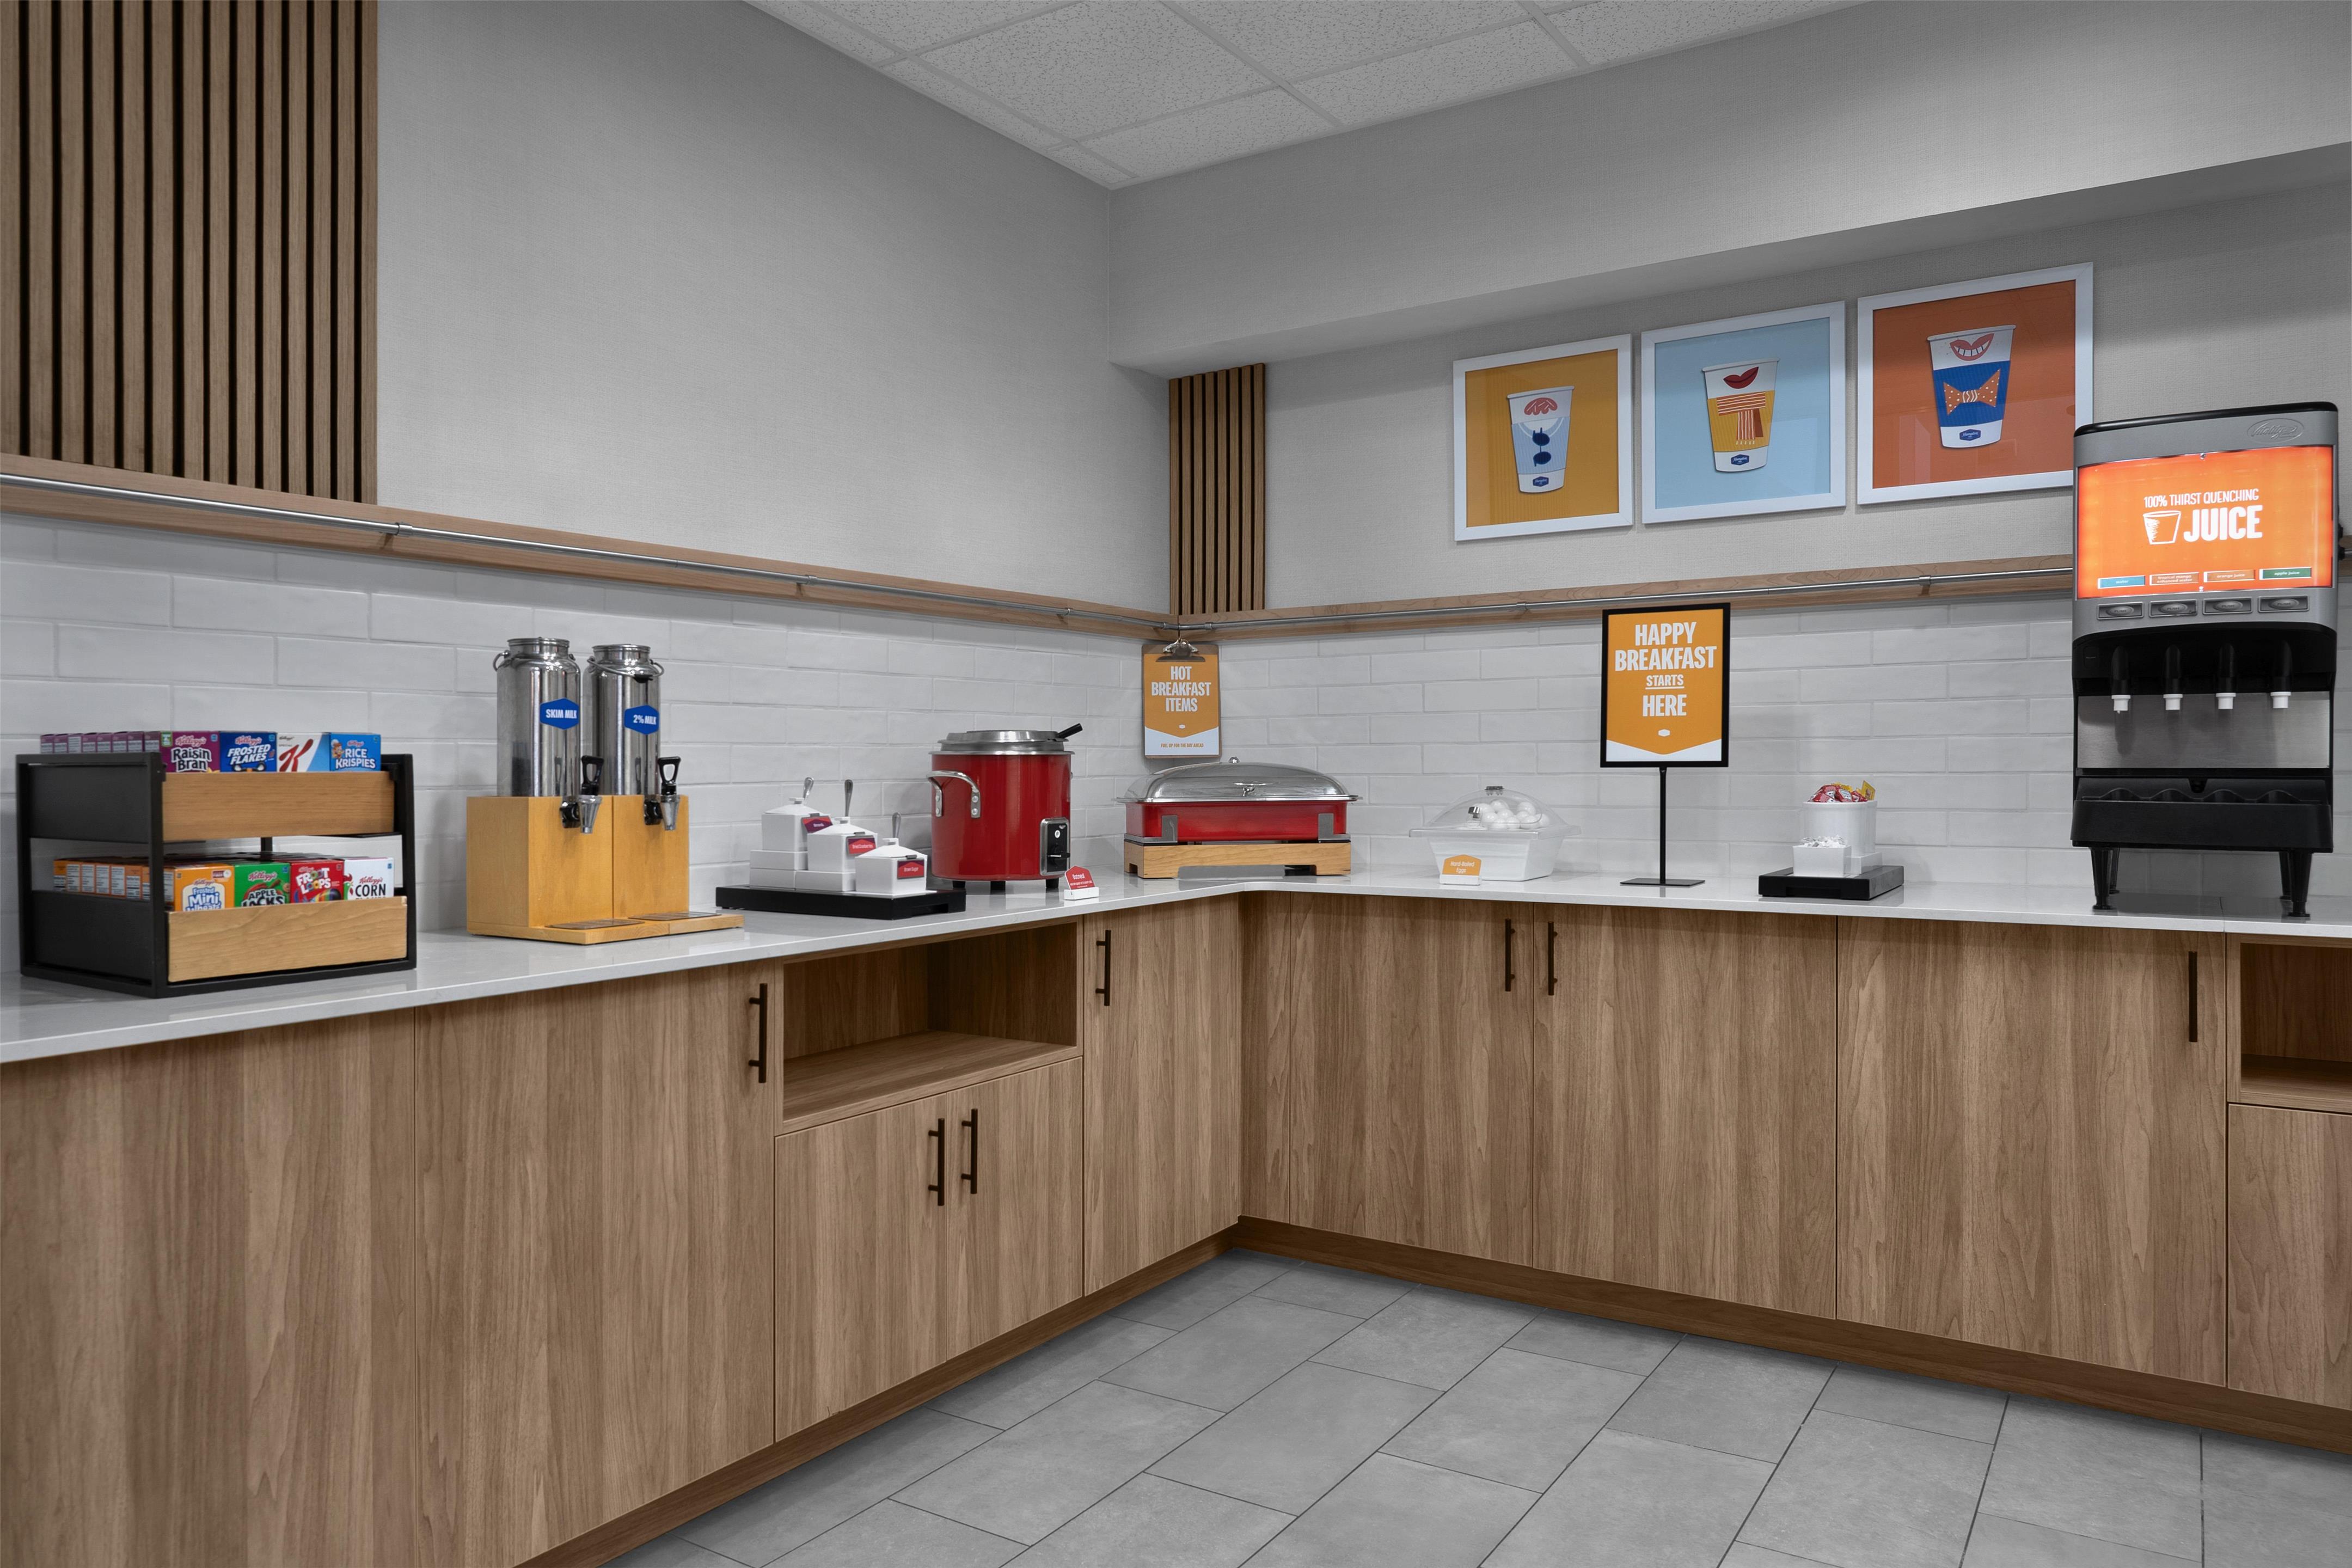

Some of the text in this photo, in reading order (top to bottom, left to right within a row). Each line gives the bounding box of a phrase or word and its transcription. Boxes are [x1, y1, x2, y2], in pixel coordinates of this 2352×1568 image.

[2143, 488, 2259, 508] 100% THIRST QUENCHING
[2183, 505, 2263, 542] JUICE
[1635, 622, 1697, 646] HAPPY
[1615, 646, 1717, 671] BREAKFAST
[1171, 666, 1192, 680] HOT
[1646, 674, 1684, 687] STARTS
[1151, 682, 1211, 696] BREAKFAST
[1165, 697, 1198, 712] ITEMS
[1642, 694, 1687, 717] HERE
[546, 709, 577, 719] SKIM MILK
[633, 714, 657, 725] 2% MILK
[171, 747, 212, 762] Raisin
[227, 744, 271, 757] FROSTED
[278, 739, 314, 771] K
[345, 748, 367, 758] RICE
[230, 752, 267, 765] FLAKES
[335, 758, 376, 769] KRISPIES
[177, 760, 207, 772] Bran
[248, 871, 277, 881] Kellogg's
[296, 867, 330, 886] FROOT
[359, 876, 383, 885] Kellogg's
[192, 886, 215, 895] Frosted
[301, 878, 332, 895] LOOPS
[356, 884, 386, 897] CORN
[189, 892, 219, 907] Mini
[249, 889, 275, 899] APPLE
